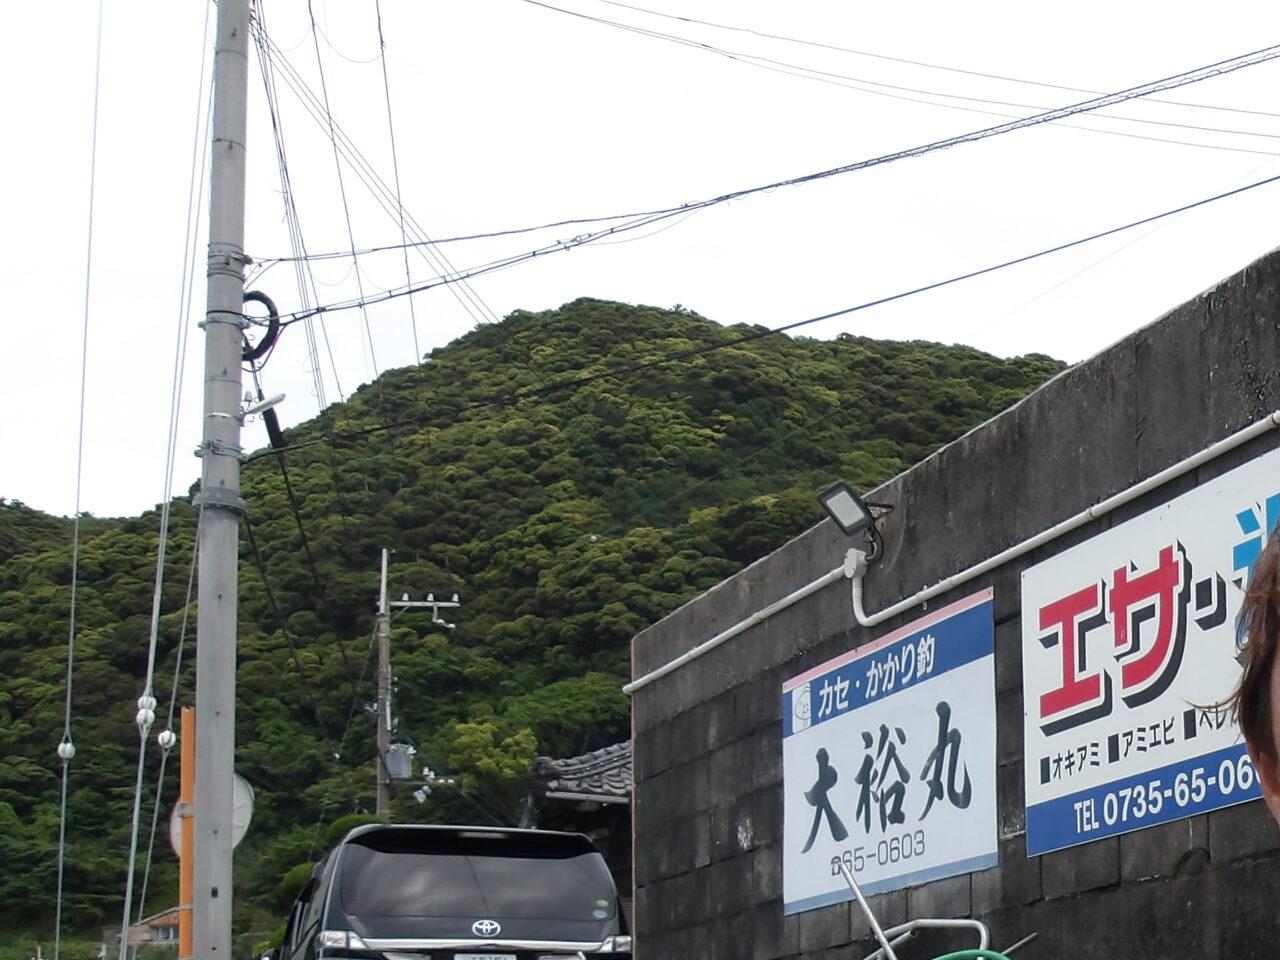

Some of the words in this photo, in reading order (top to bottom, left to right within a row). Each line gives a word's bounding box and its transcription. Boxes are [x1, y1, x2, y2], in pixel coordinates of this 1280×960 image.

[800, 701, 972, 854] 大裕丸
[1053, 742, 1100, 780] オキアミ
[1122, 716, 1176, 759] アミエビ
[1074, 798, 1100, 834] TEL
[1103, 754, 1261, 826] 0735-65-06
